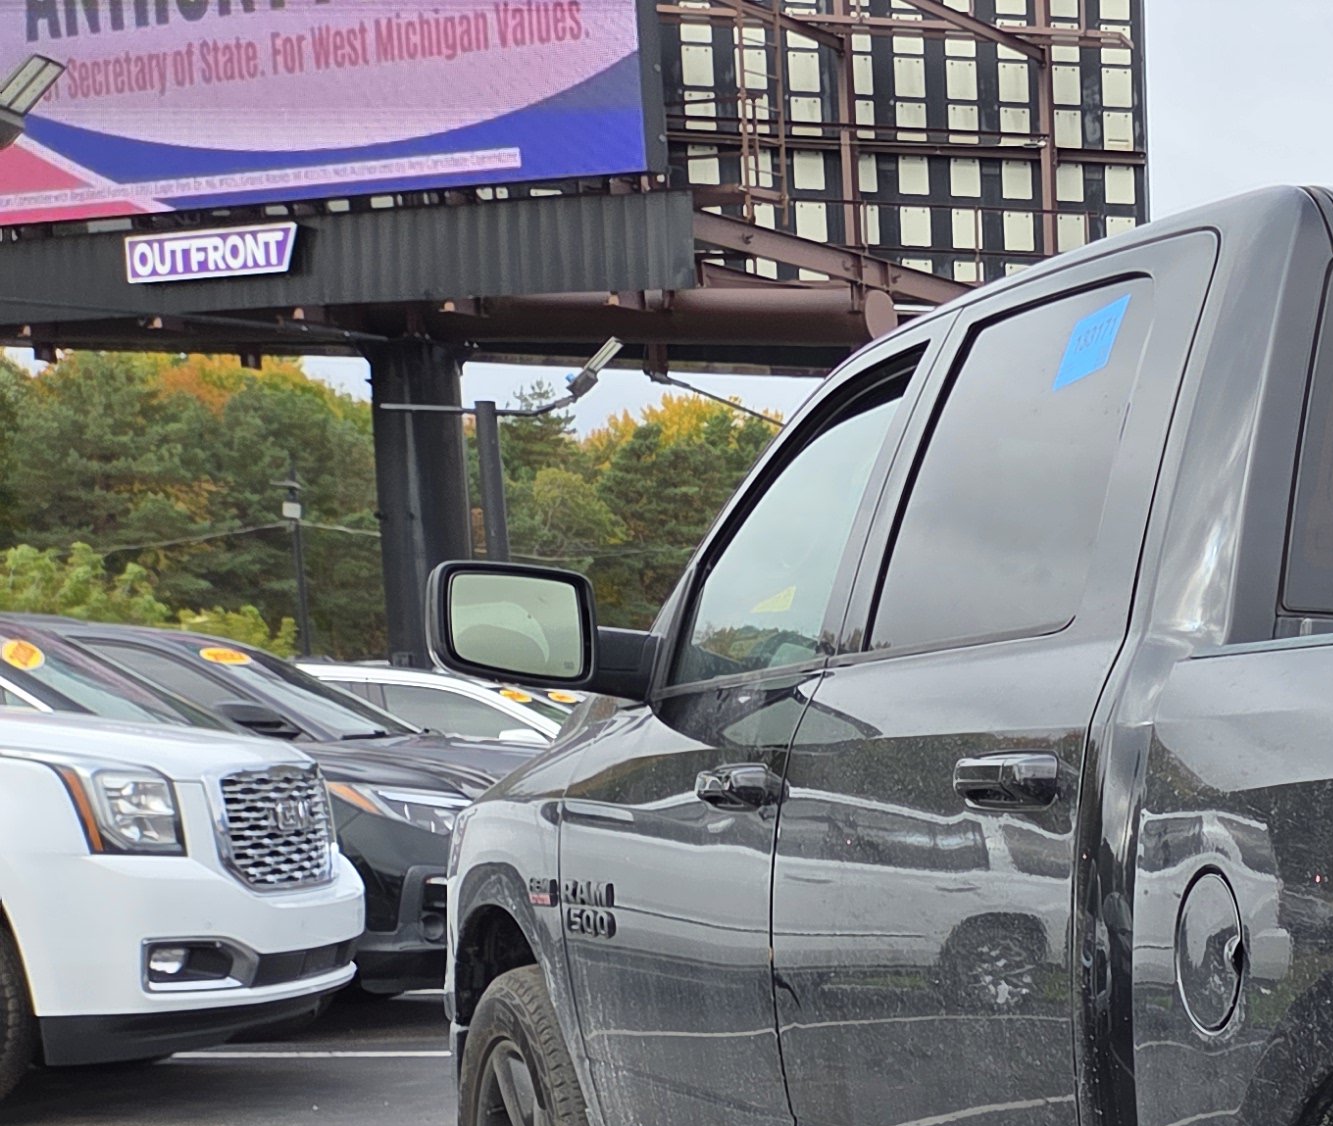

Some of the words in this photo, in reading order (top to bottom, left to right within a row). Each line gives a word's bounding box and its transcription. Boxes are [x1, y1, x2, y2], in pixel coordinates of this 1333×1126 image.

[66, 51, 168, 98] Secretary
[174, 42, 196, 88] of
[201, 37, 267, 85] State.
[270, 31, 306, 75] For
[311, 20, 369, 70] West
[374, 8, 490, 63] Michigan
[494, 0, 590, 49] Values.
[133, 230, 284, 276] OUTFRONT
[561, 879, 615, 908] RAM
